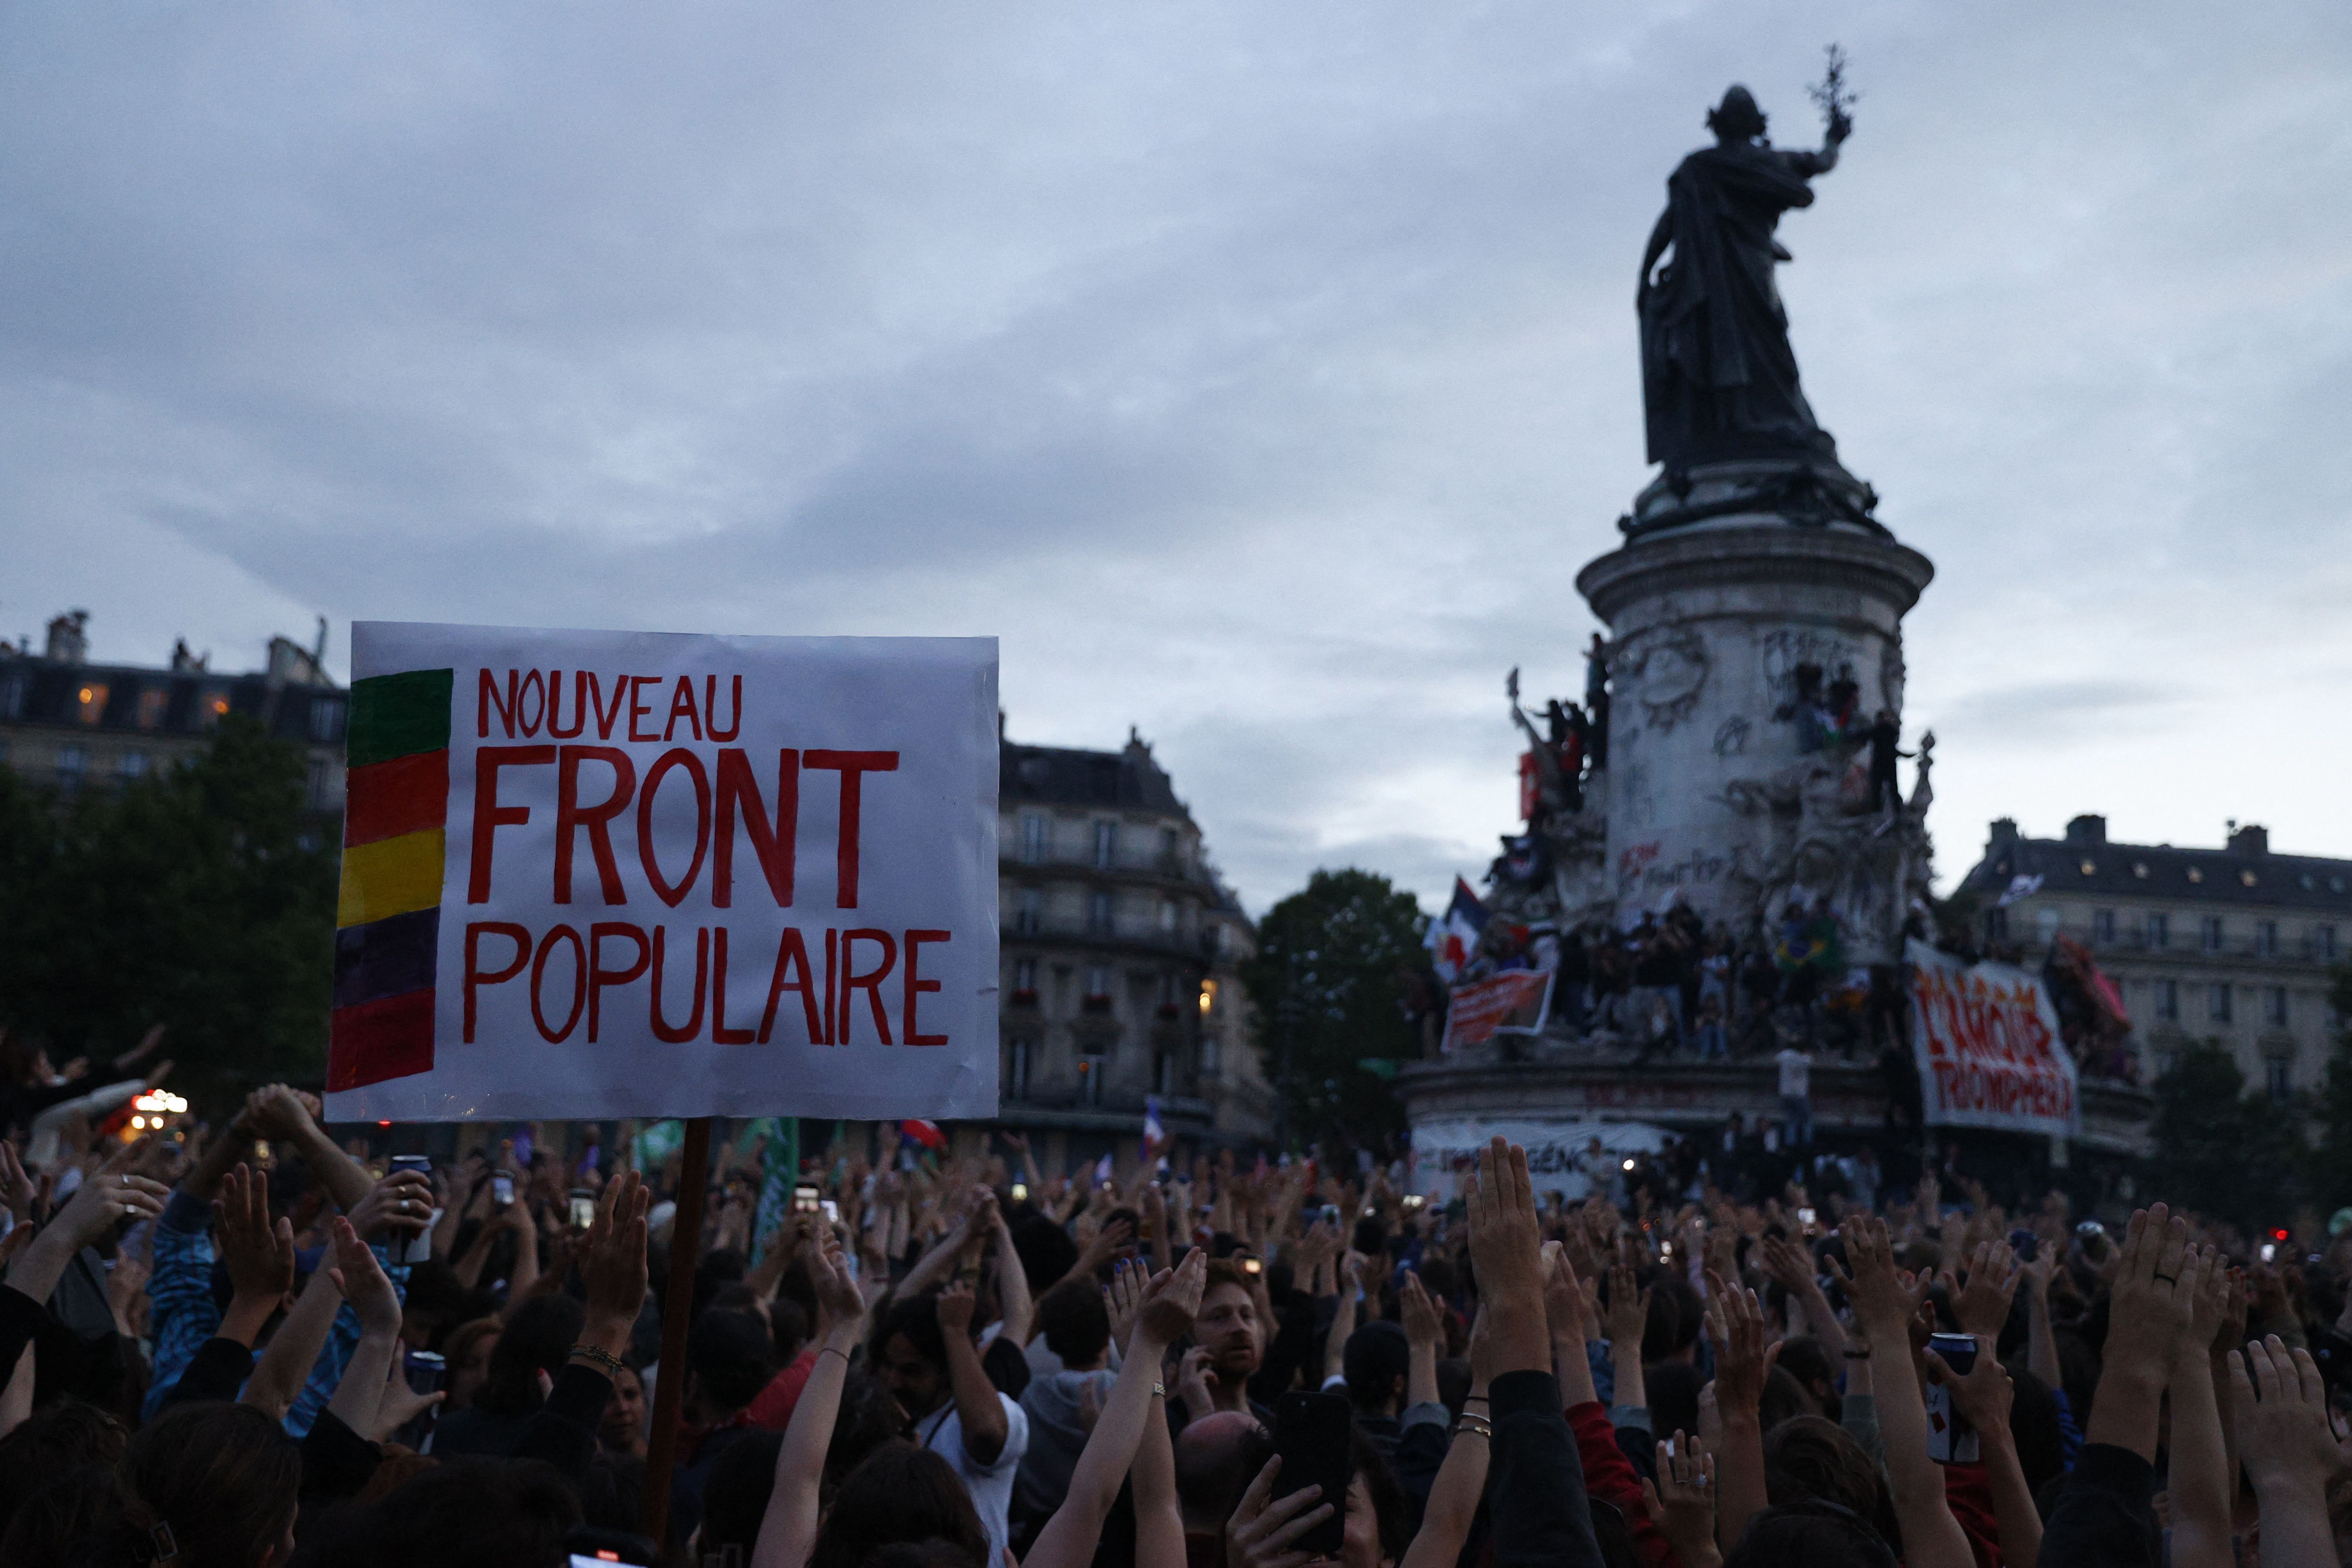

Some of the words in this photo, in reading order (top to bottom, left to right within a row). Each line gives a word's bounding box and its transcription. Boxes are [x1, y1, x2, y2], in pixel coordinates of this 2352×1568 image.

[477, 669, 741, 742] NOUVEAU
[468, 745, 899, 908] FRONT
[463, 922, 950, 1046] POPULAIRE
